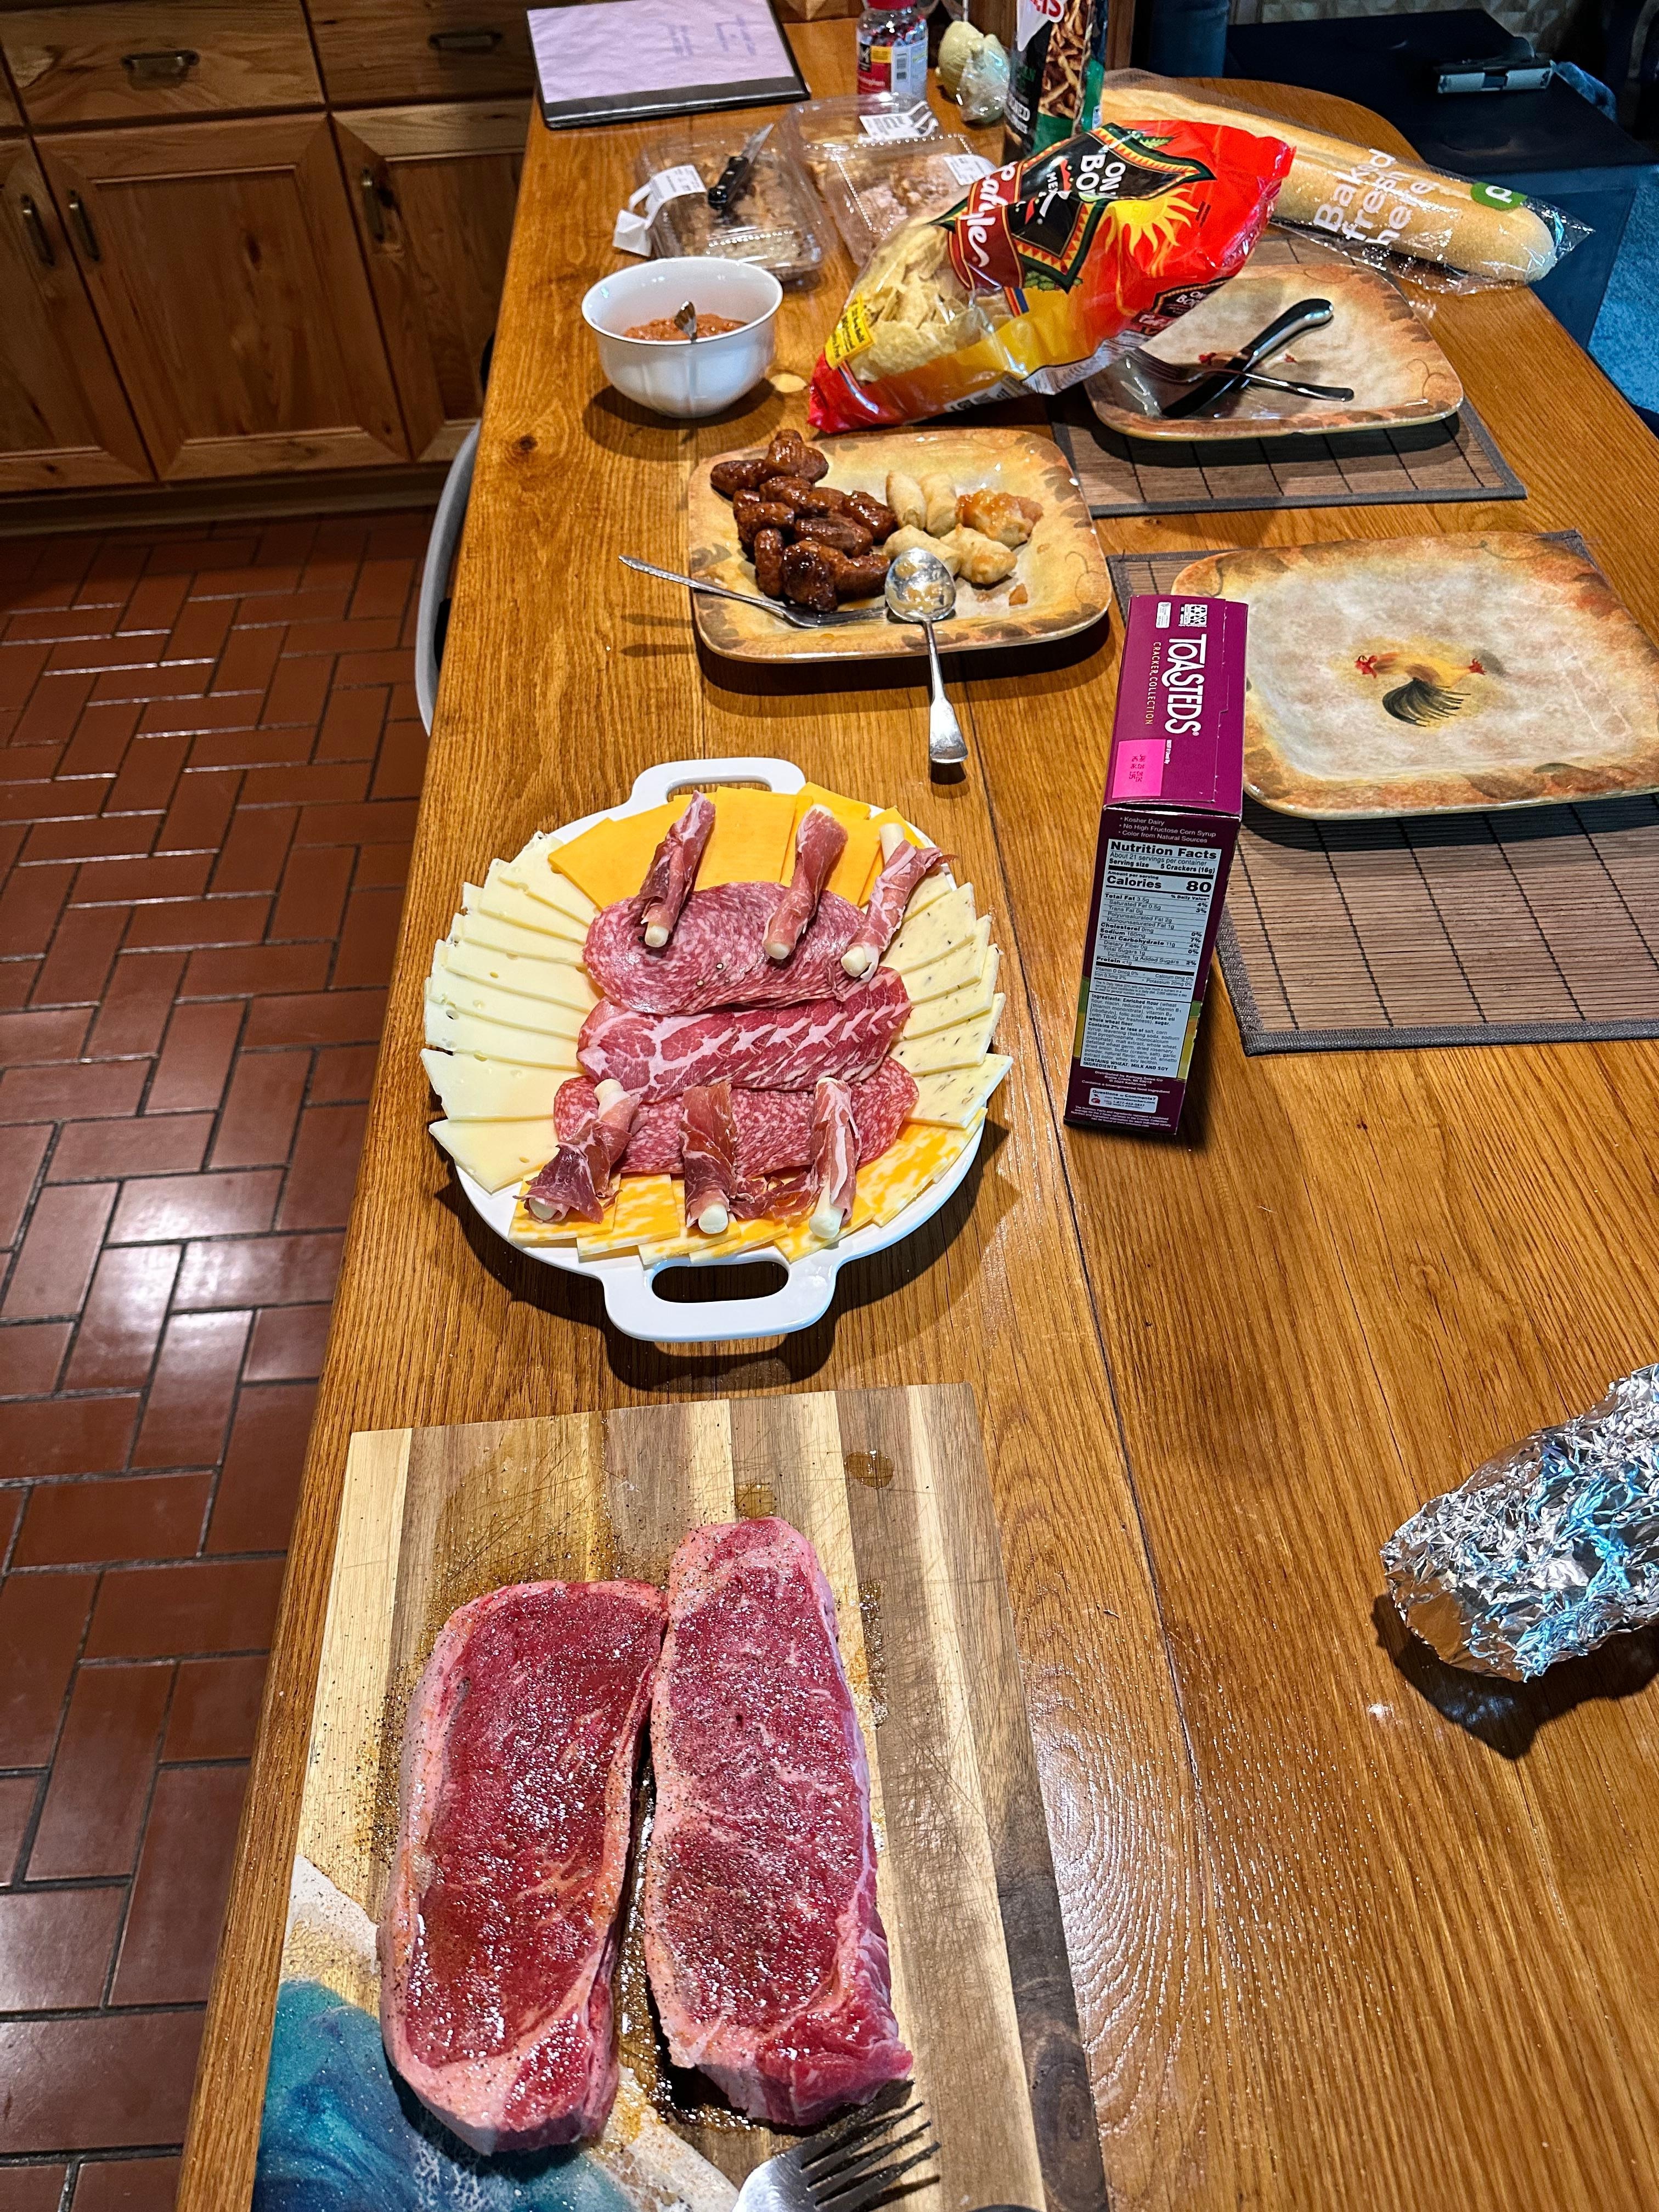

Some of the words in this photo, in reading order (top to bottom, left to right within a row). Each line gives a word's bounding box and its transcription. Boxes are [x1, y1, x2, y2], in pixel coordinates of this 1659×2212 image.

[1313, 148, 1397, 233] Baked
[1341, 170, 1412, 241] fresh
[1149, 641, 1161, 676] CRACKER
[1161, 633, 1207, 734] TOASTEDS
[1144, 676, 1158, 725] COLLECTION
[1110, 841, 1172, 855] Nutrition
[1177, 848, 1216, 859] Facts
[1109, 857, 1134, 867] Serving
[1166, 864, 1196, 872] Crackers
[1138, 855, 1164, 864] servings
[1177, 857, 1207, 866] container
[1107, 875, 1161, 888] Calories
[1185, 879, 1212, 893] 80
[1101, 922, 1140, 931] Cholesterol
[1118, 935, 1165, 946] Carbohydrate
